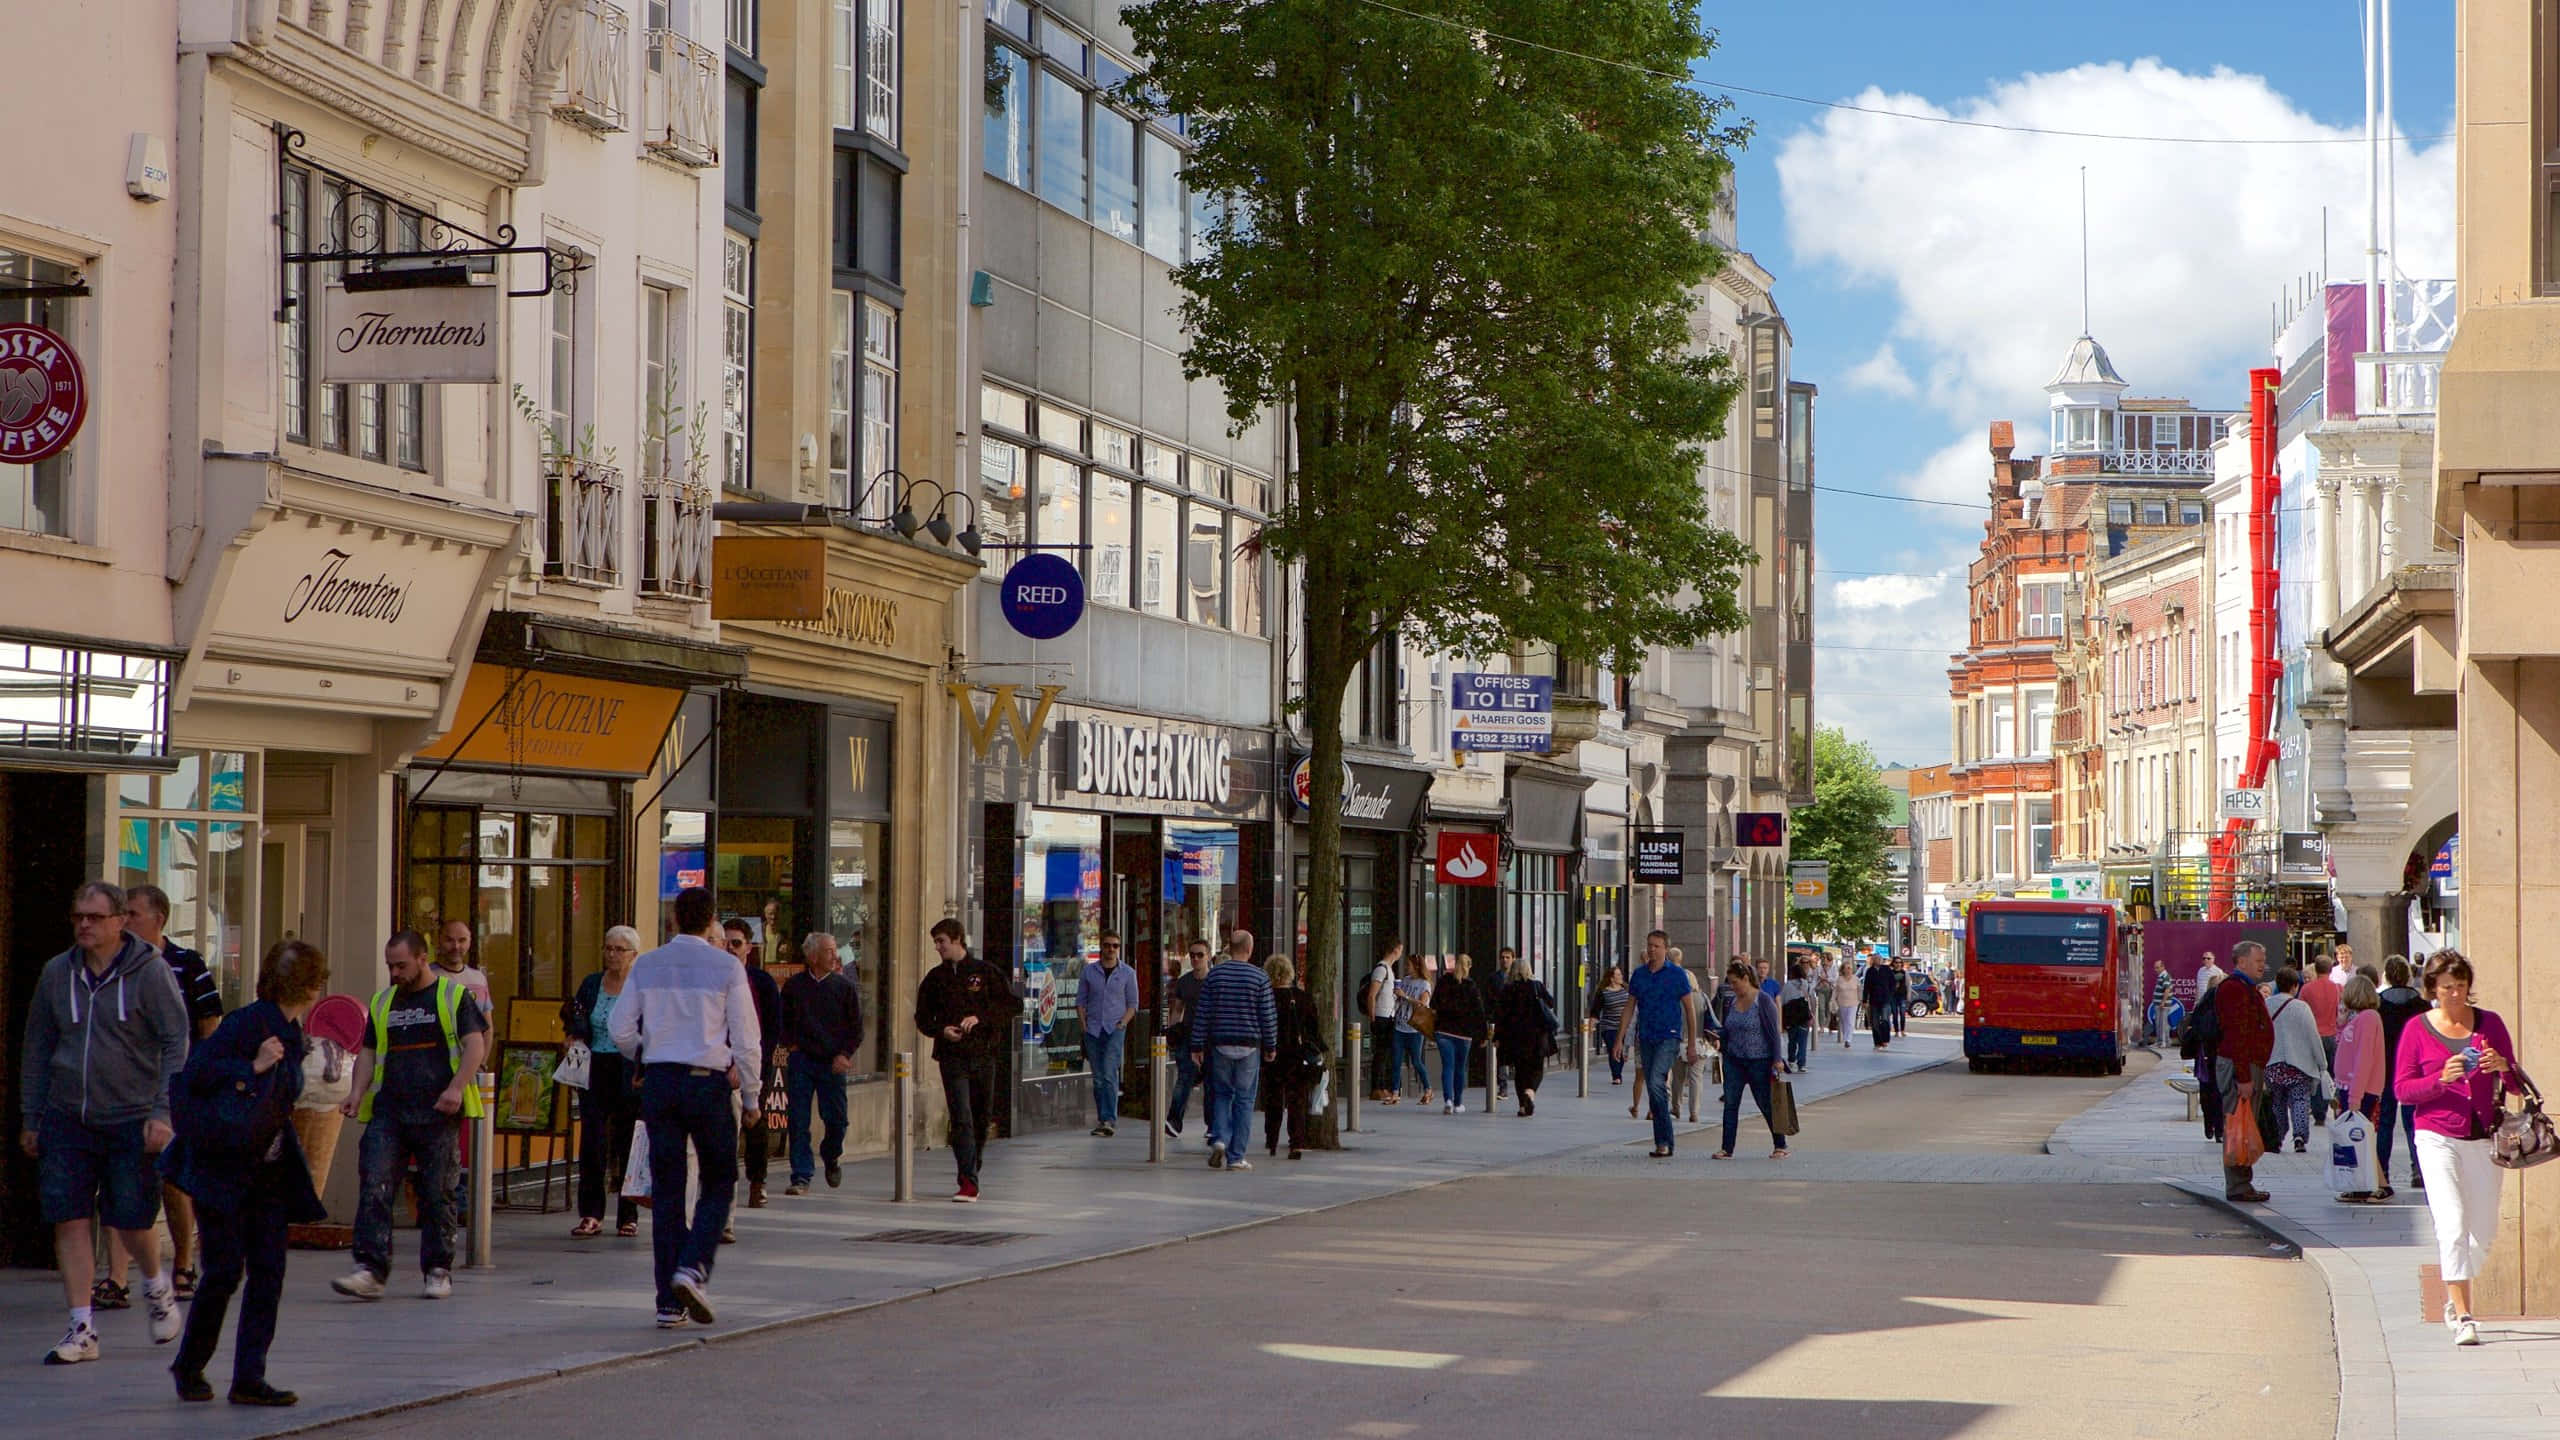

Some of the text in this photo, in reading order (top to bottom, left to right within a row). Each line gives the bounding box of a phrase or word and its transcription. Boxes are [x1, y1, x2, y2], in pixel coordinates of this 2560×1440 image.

[337, 312, 486, 353] Thorntons
[0, 334, 57, 370] OSTA
[55, 381, 72, 391] 1971
[0, 406, 69, 451] FFEE
[284, 548, 412, 623] Thorntons
[1017, 585, 1067, 604] REED
[1474, 676, 1531, 689] OFFICES
[1466, 691, 1540, 709] TO LET
[944, 684, 1067, 760] W
[1471, 713, 1546, 726] HAARER GOSS
[1461, 733, 1545, 744] 01392 251171
[849, 736, 870, 793] W
[1077, 720, 1231, 804] BURGER KING
[1343, 783, 1392, 819] Santander
[2225, 791, 2262, 809] APEX
[1640, 842, 1680, 854] LUSH
[1640, 867, 1680, 875] COSMETICS
